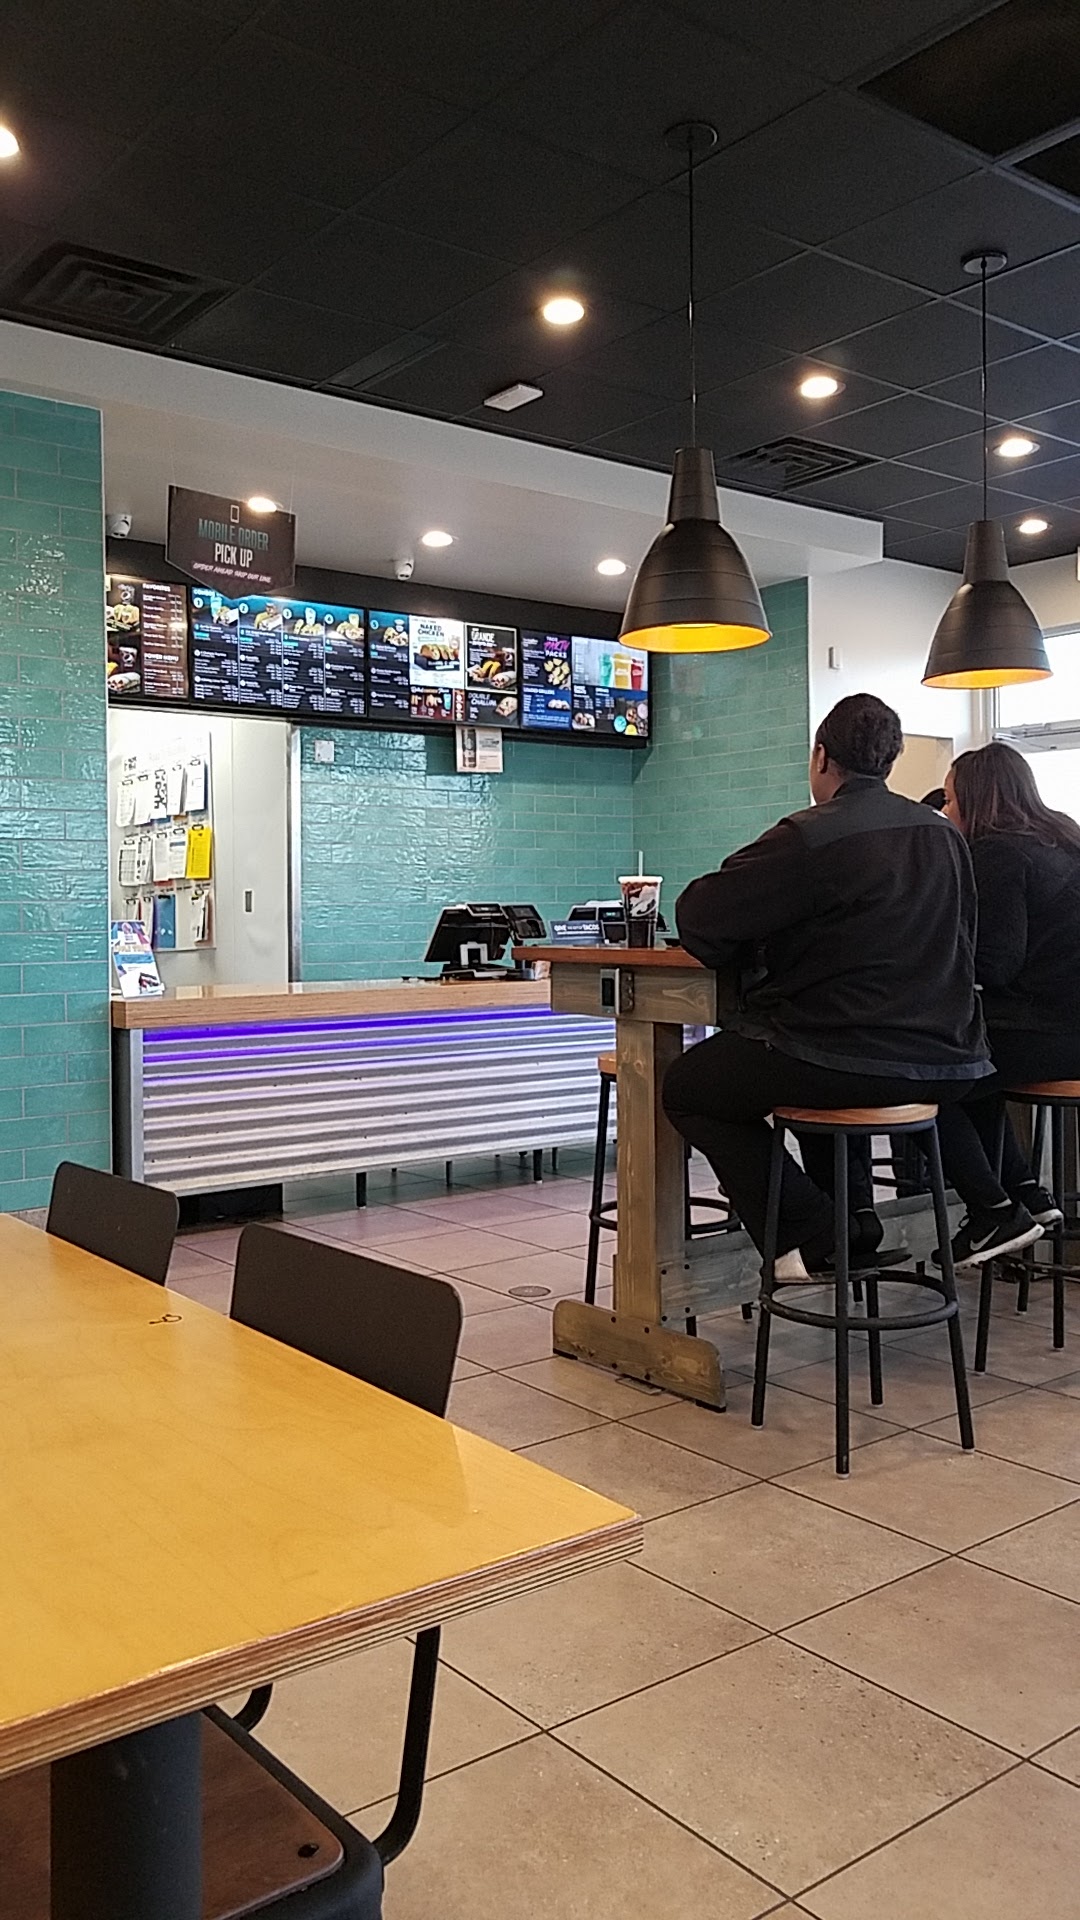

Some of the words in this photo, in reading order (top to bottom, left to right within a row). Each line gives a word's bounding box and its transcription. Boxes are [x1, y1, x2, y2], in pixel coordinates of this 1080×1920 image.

[198, 518, 235, 543] MOBILE
[238, 527, 269, 551] ORDER
[215, 542, 237, 565] PICK
[240, 548, 253, 568] UP
[418, 628, 444, 637] CHICKEN
[420, 624, 442, 632] NAKED
[545, 650, 567, 658] PACKS
